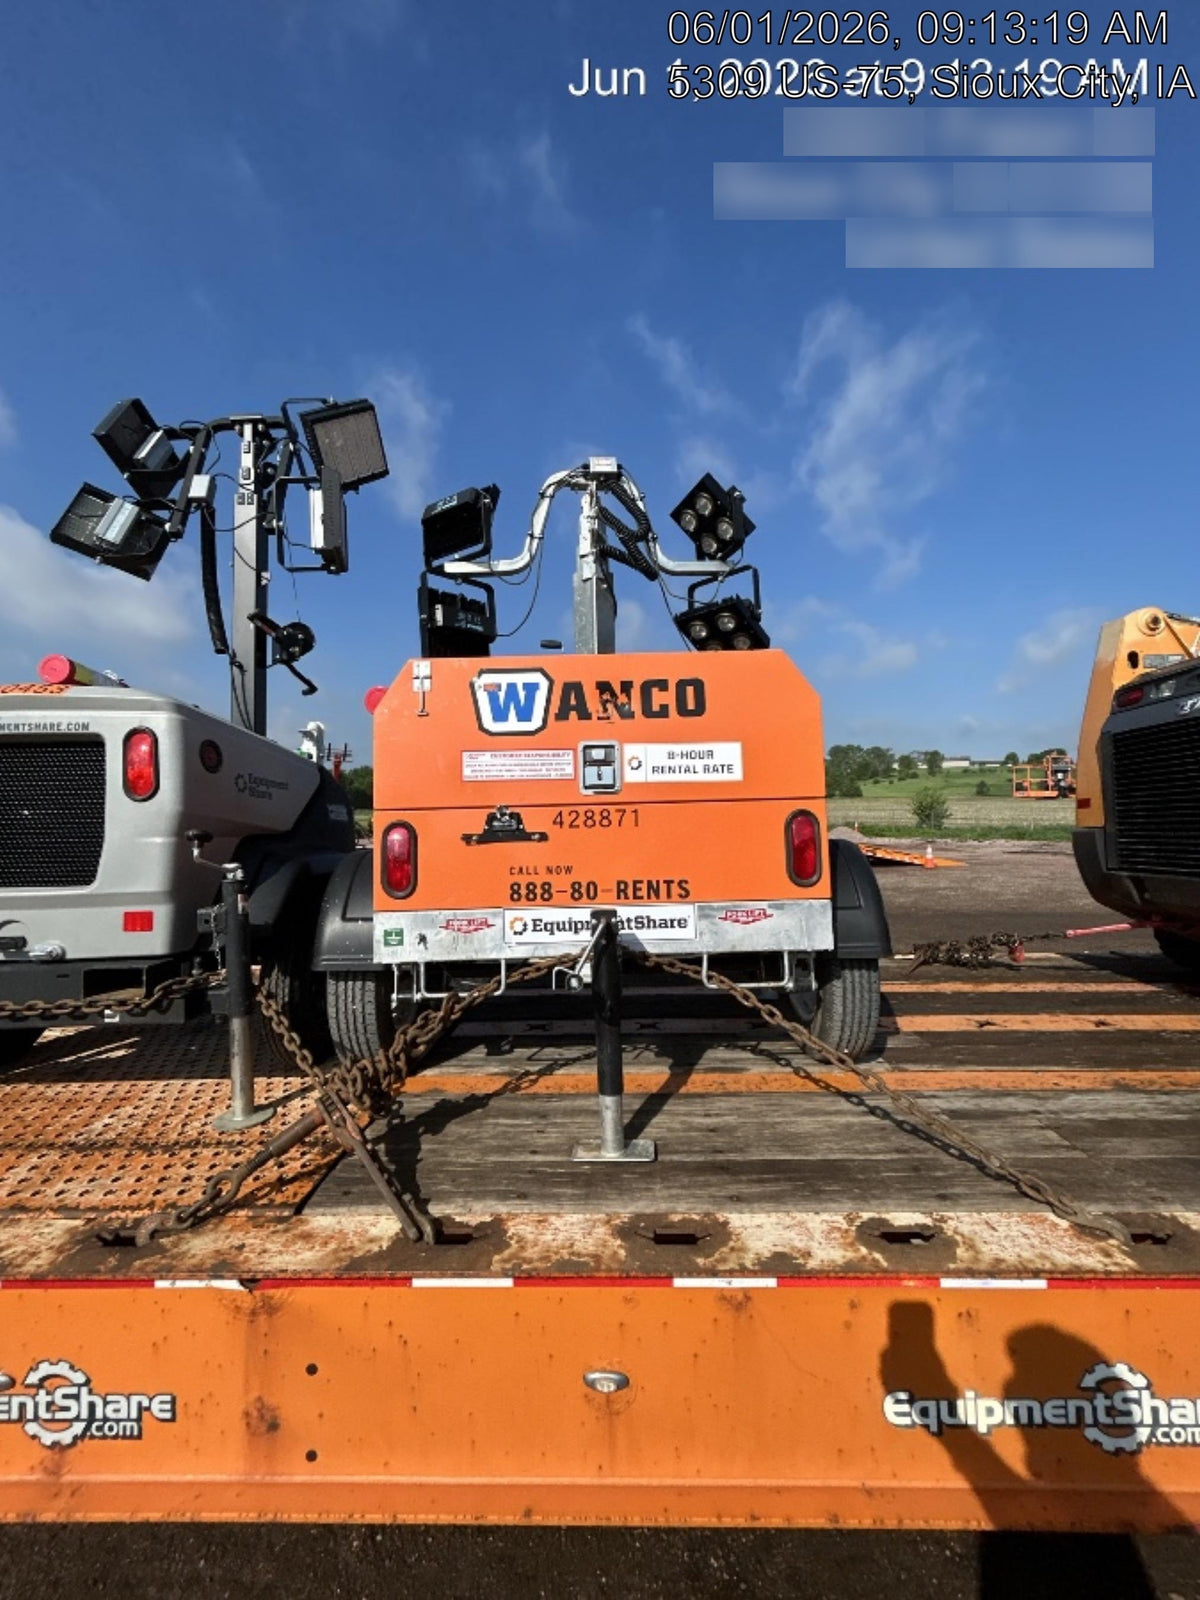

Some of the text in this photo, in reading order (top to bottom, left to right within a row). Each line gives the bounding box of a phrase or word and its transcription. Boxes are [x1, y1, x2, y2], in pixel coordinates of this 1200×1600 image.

[482, 676, 707, 724] WANCO
[651, 763, 735, 776] RENTAL RATE
[552, 808, 640, 830] 428871
[509, 864, 574, 877] CALL NOW
[509, 878, 692, 903] 888-80-RENTS
[882, 1389, 1200, 1434] EquipmentSha
[87, 1420, 141, 1438] .com
